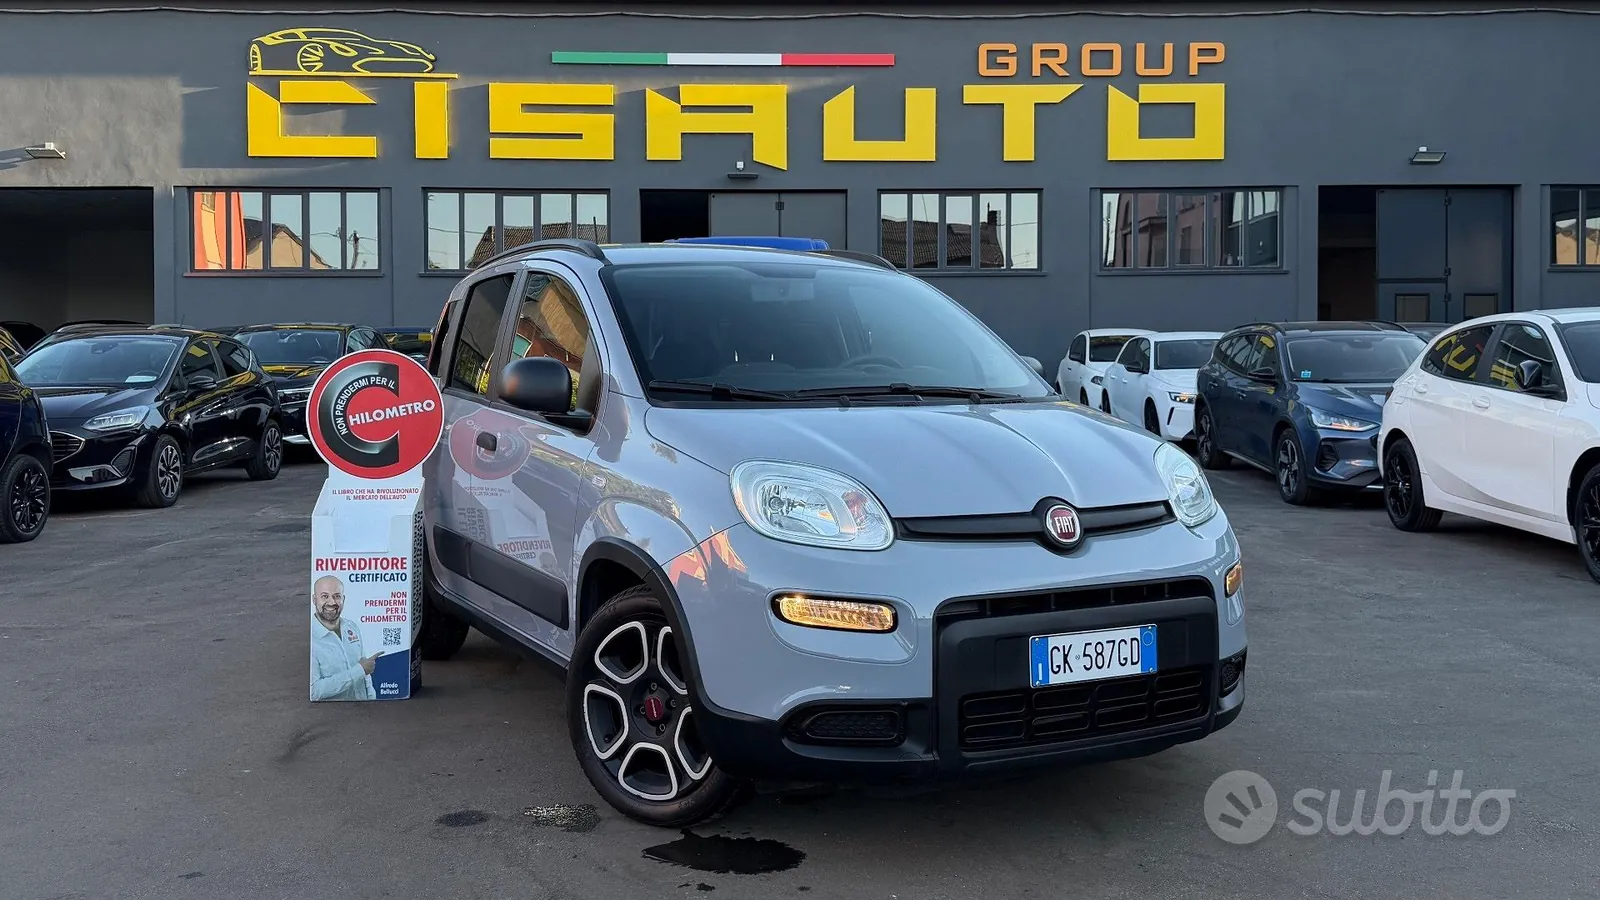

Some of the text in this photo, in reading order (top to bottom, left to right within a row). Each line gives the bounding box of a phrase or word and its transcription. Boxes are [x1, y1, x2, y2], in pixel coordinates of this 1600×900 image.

[978, 42, 1225, 77] GROUP
[247, 80, 1225, 170] CISAUTO
[335, 376, 396, 436] NON PRENDERMI PER IL
[1054, 516, 1075, 534] FIAT
[315, 557, 408, 571] RIVENDITORE
[348, 572, 408, 583] CERTIFICATO
[391, 591, 407, 599] NON
[364, 599, 407, 607] PRENDERMI
[385, 607, 399, 615] PER
[360, 615, 407, 623] CHILOMETRO
